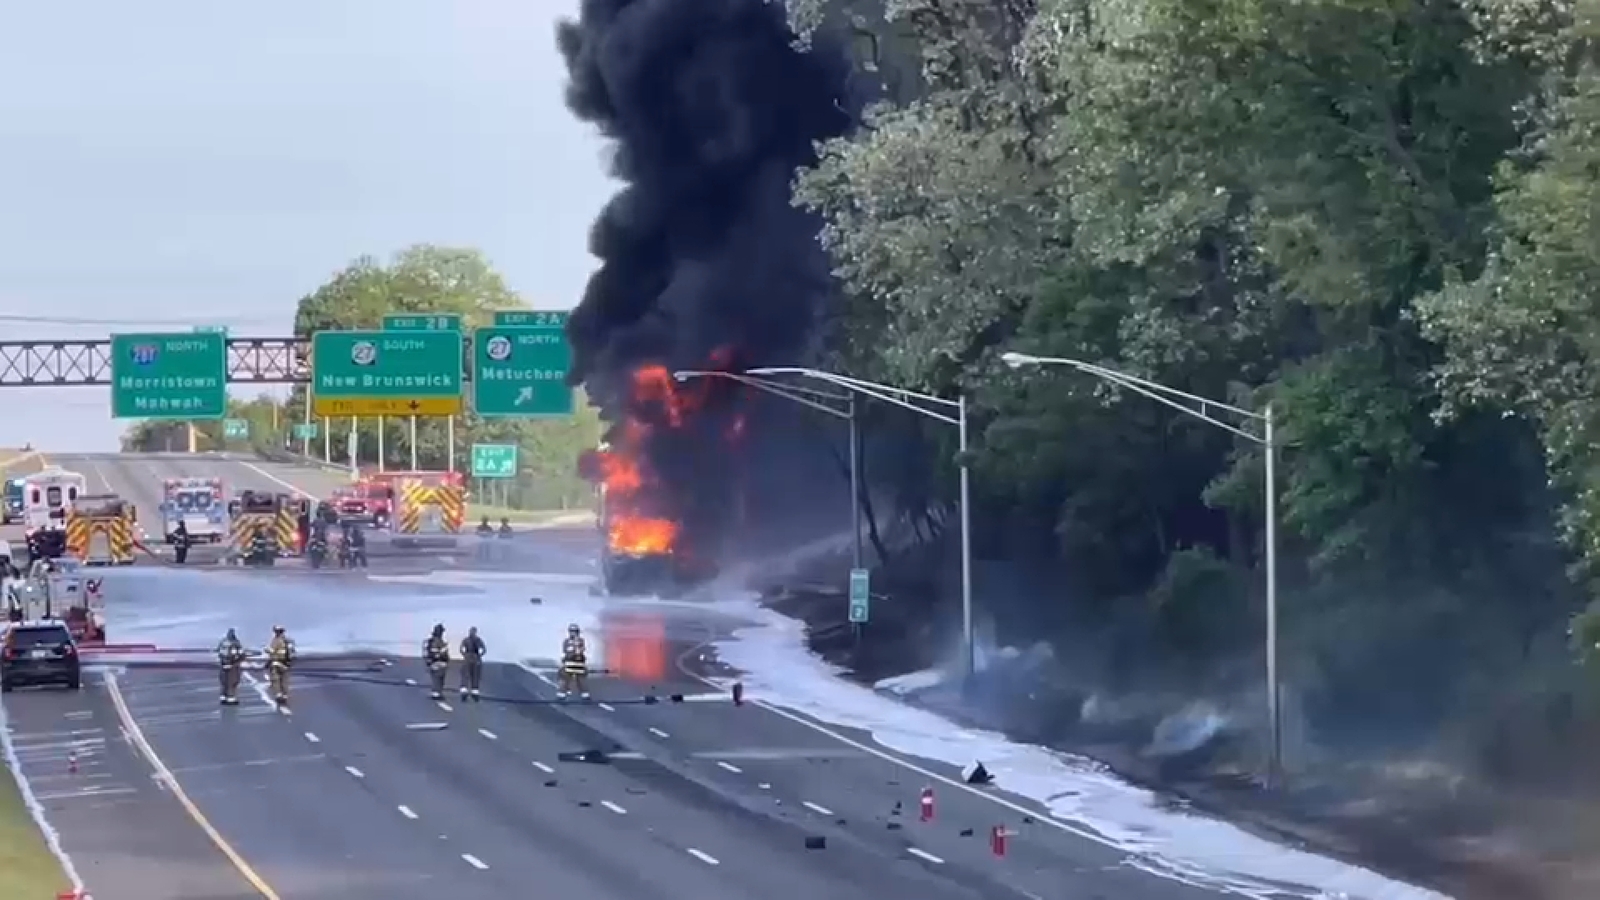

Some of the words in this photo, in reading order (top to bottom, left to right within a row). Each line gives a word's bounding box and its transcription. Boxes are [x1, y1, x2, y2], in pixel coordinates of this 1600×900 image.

[427, 317, 448, 329] 2B
[536, 312, 560, 324] 2A
[166, 340, 209, 351] NORTH
[383, 340, 425, 351] SOUTH
[518, 335, 559, 344] NORTH
[354, 345, 374, 359] 27
[490, 341, 508, 355] 27
[482, 367, 564, 379] Metuchen
[121, 376, 216, 389] Morristown
[322, 374, 357, 387] New
[362, 373, 453, 387] Brunswick
[134, 396, 203, 409] Mahwah
